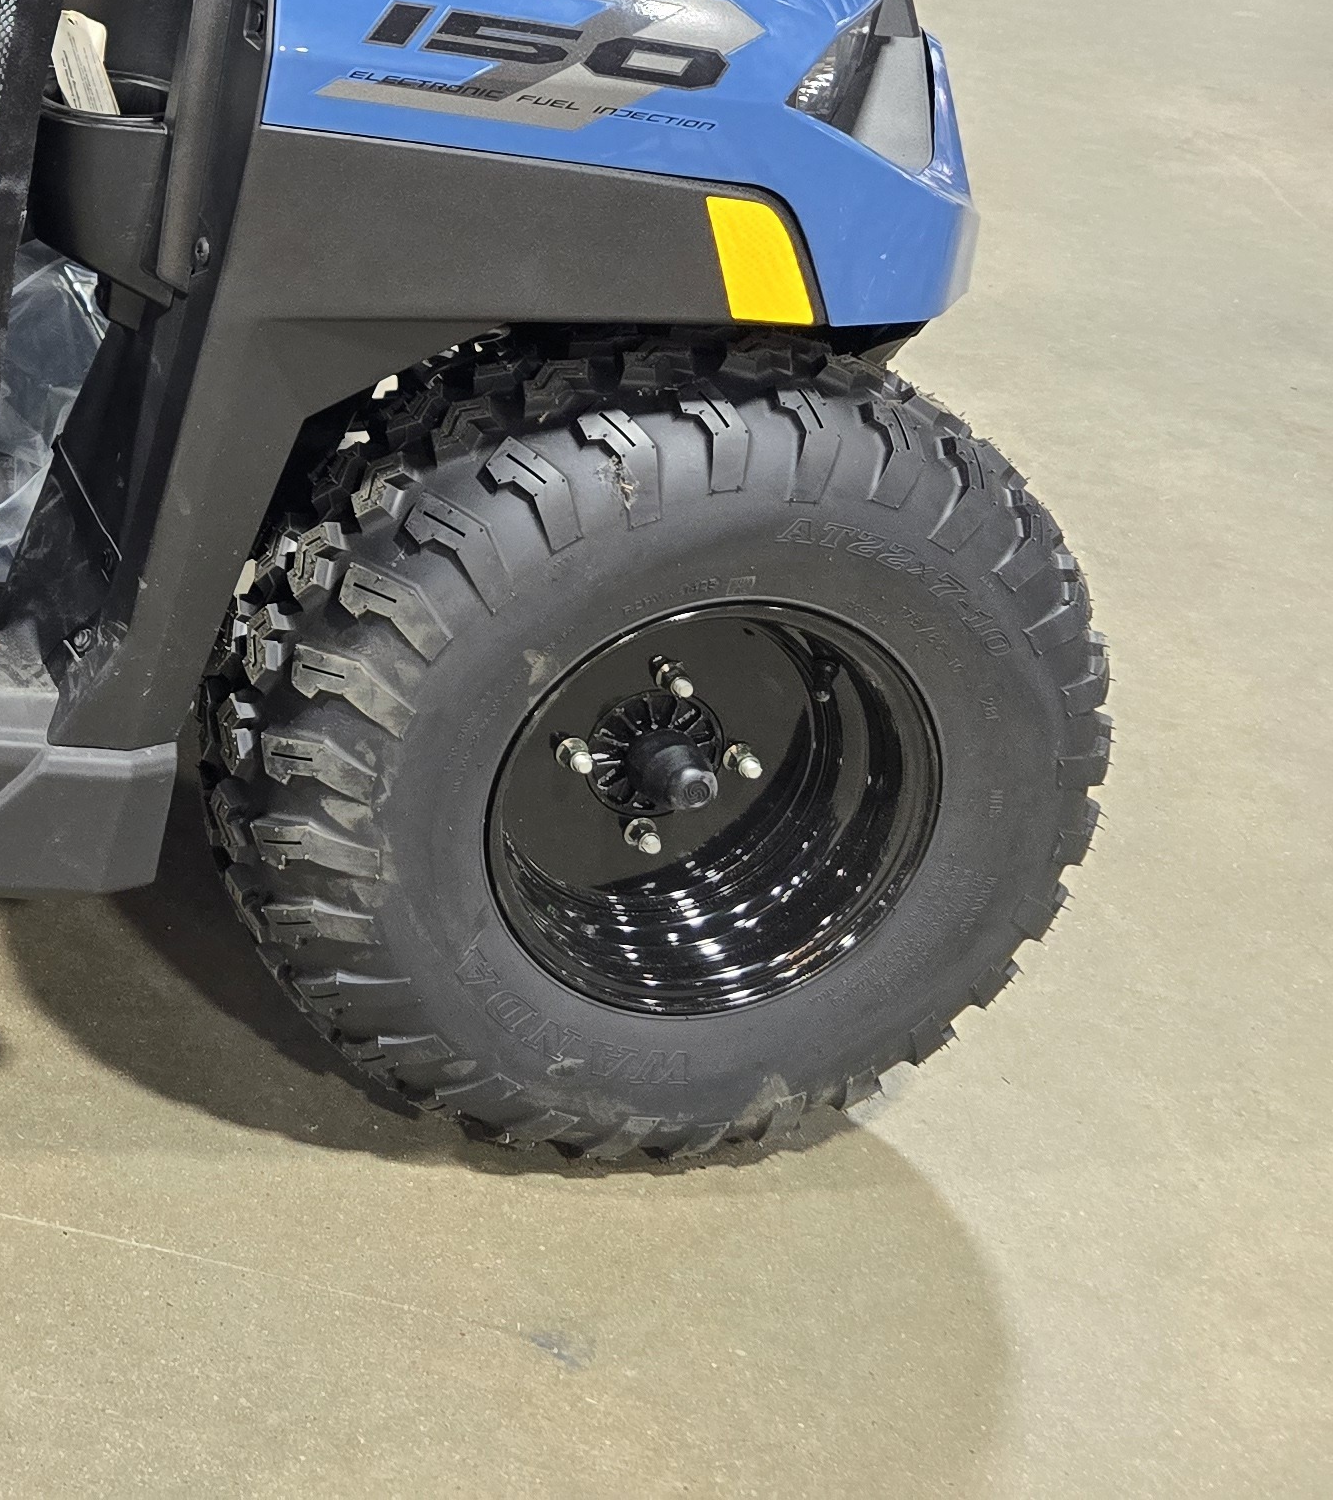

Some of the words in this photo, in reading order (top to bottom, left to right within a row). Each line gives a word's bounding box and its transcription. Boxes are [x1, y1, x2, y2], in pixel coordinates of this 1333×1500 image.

[360, 0, 731, 91] 150
[348, 70, 505, 100] ELECTRONIC
[515, 94, 580, 112] FUEL
[592, 105, 717, 131] INJECTION
[453, 940, 691, 1085] WANDA
